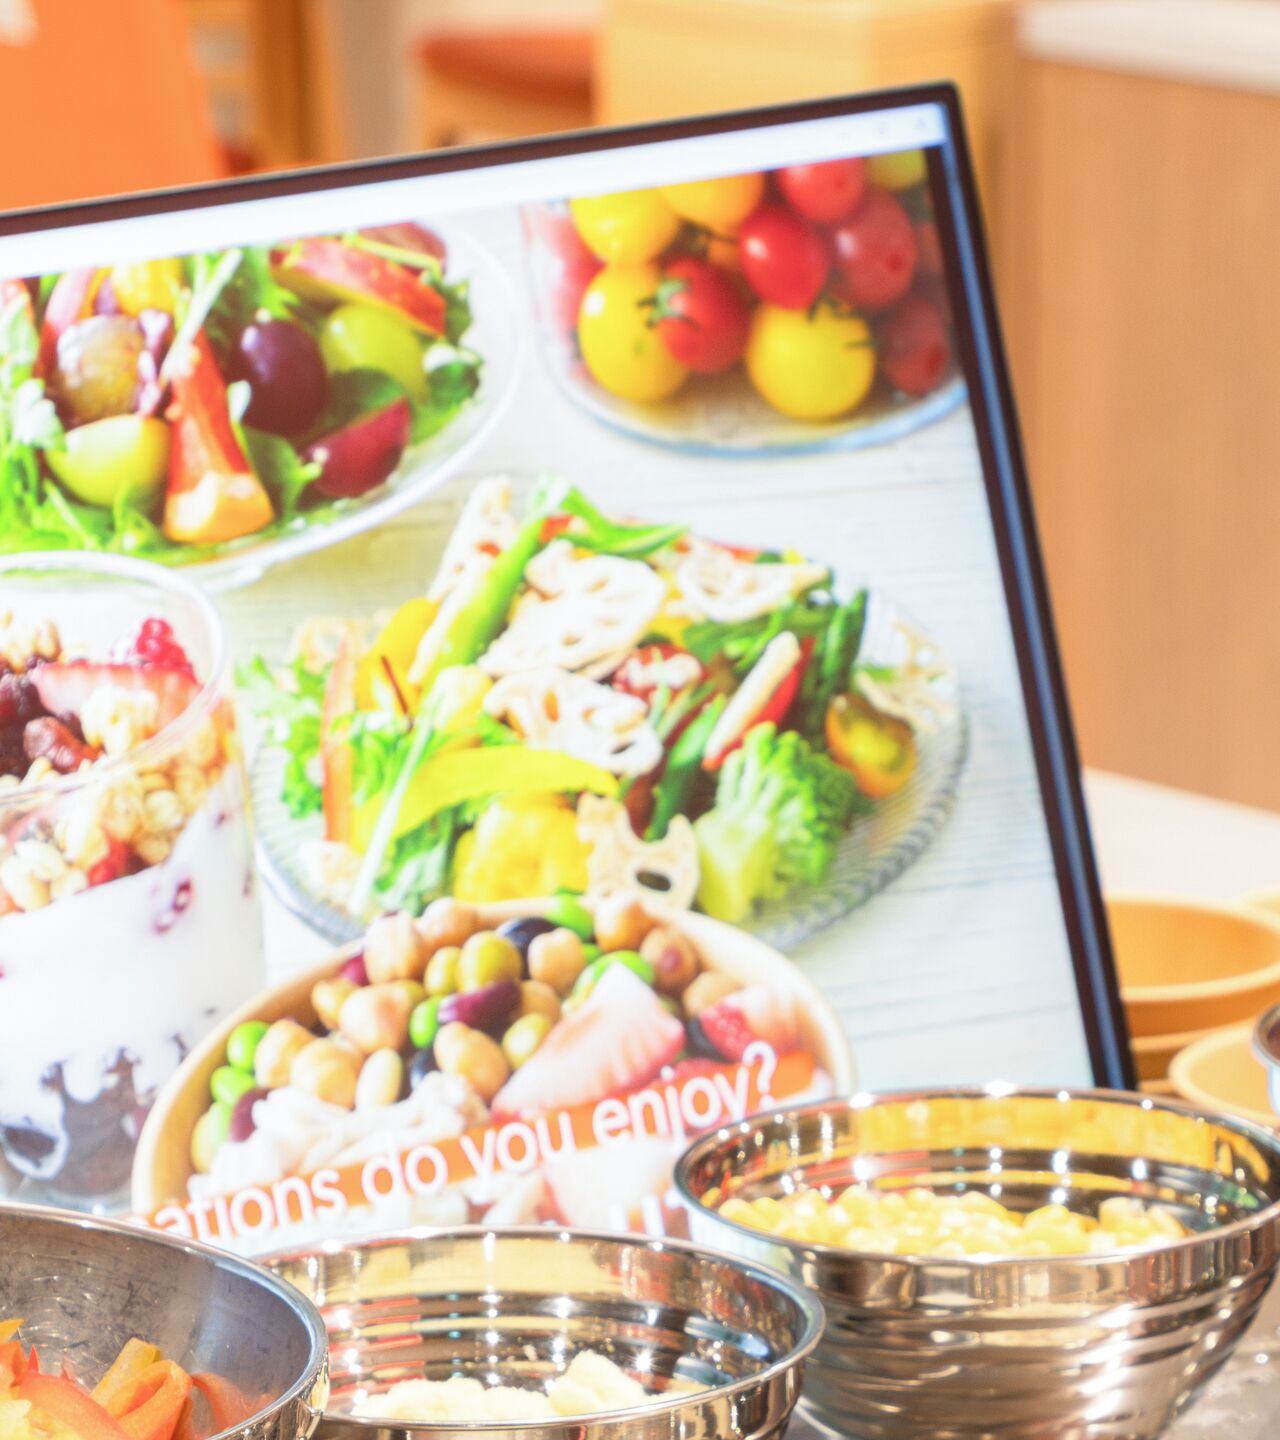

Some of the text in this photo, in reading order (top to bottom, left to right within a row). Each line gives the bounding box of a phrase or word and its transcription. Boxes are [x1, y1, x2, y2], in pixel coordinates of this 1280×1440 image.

[126, 1040, 777, 1243] ations do you enjoy?
